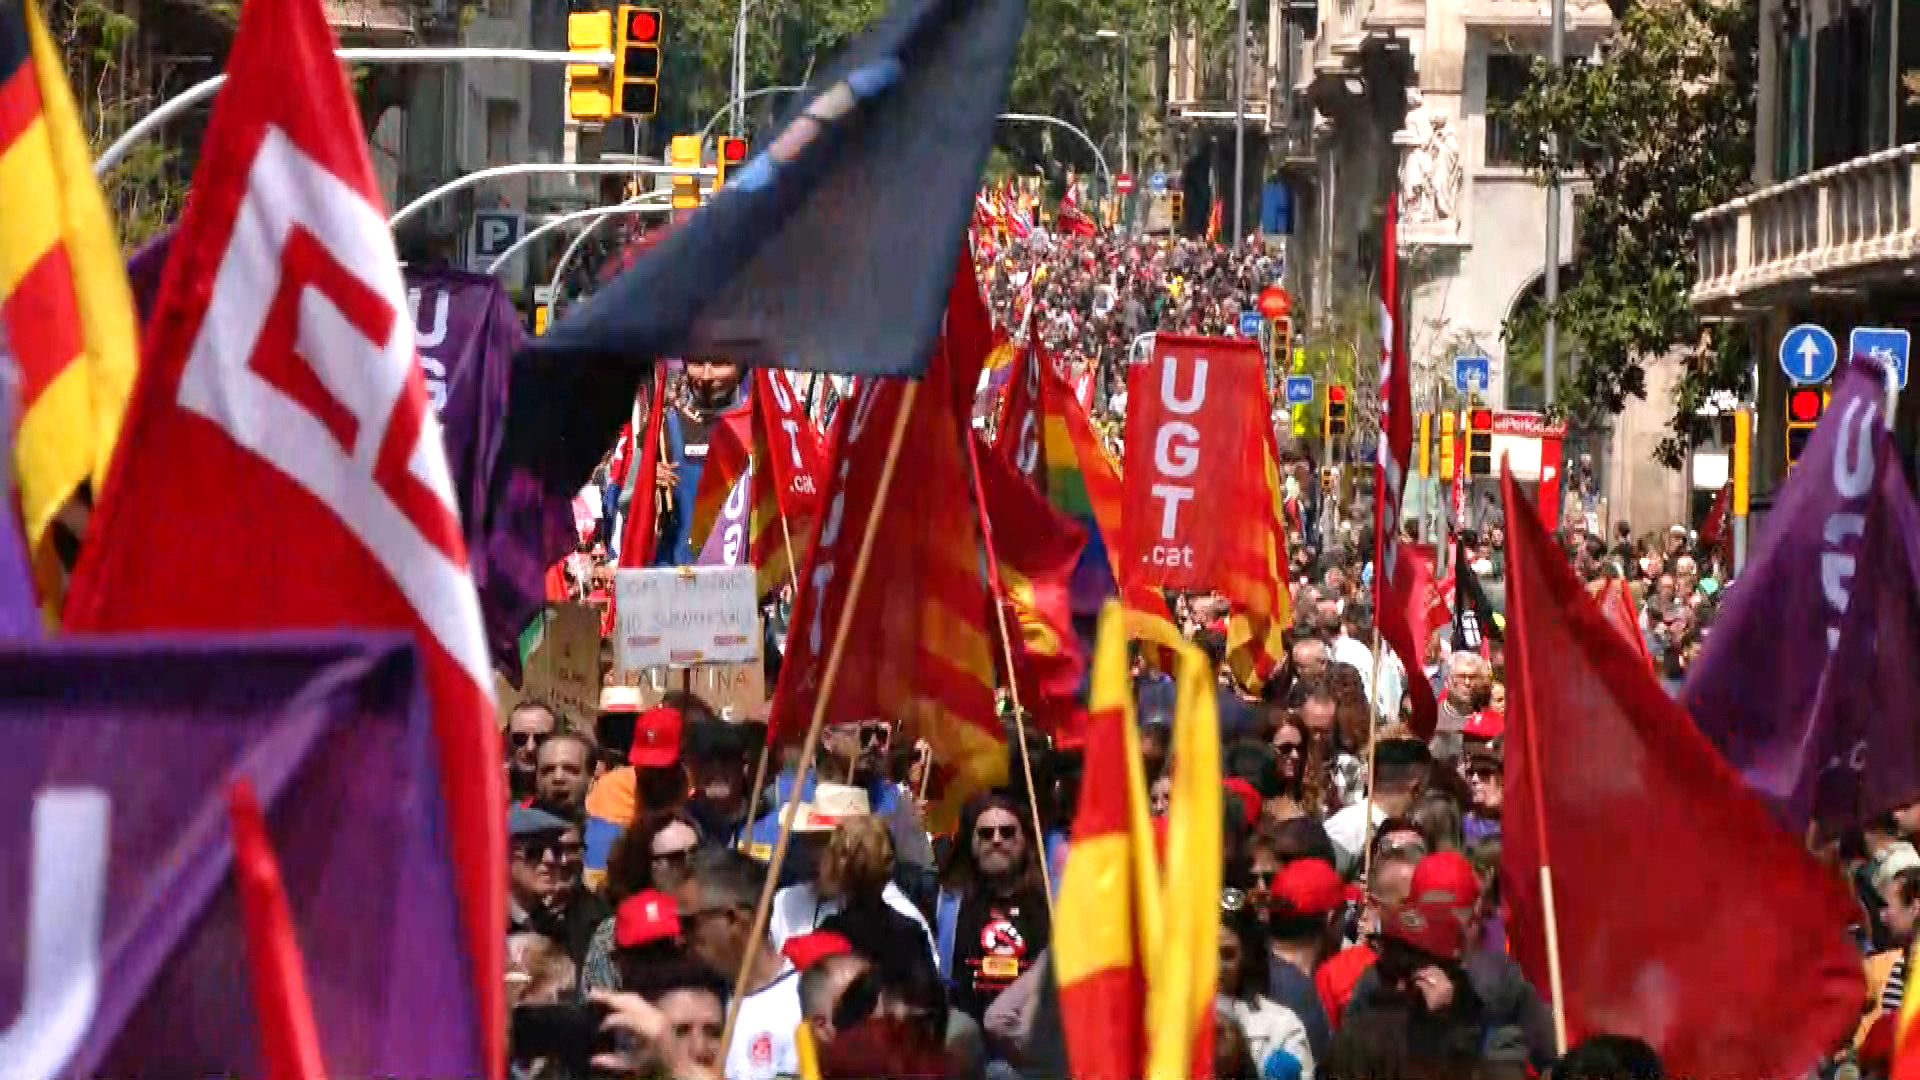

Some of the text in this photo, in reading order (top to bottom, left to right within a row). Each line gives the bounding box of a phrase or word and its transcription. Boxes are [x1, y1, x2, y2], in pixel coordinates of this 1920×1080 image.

[482, 218, 510, 251] P
[1153, 356, 1209, 540] UGT
[1142, 545, 1194, 568] .cat
[624, 664, 748, 692] PALTINA
